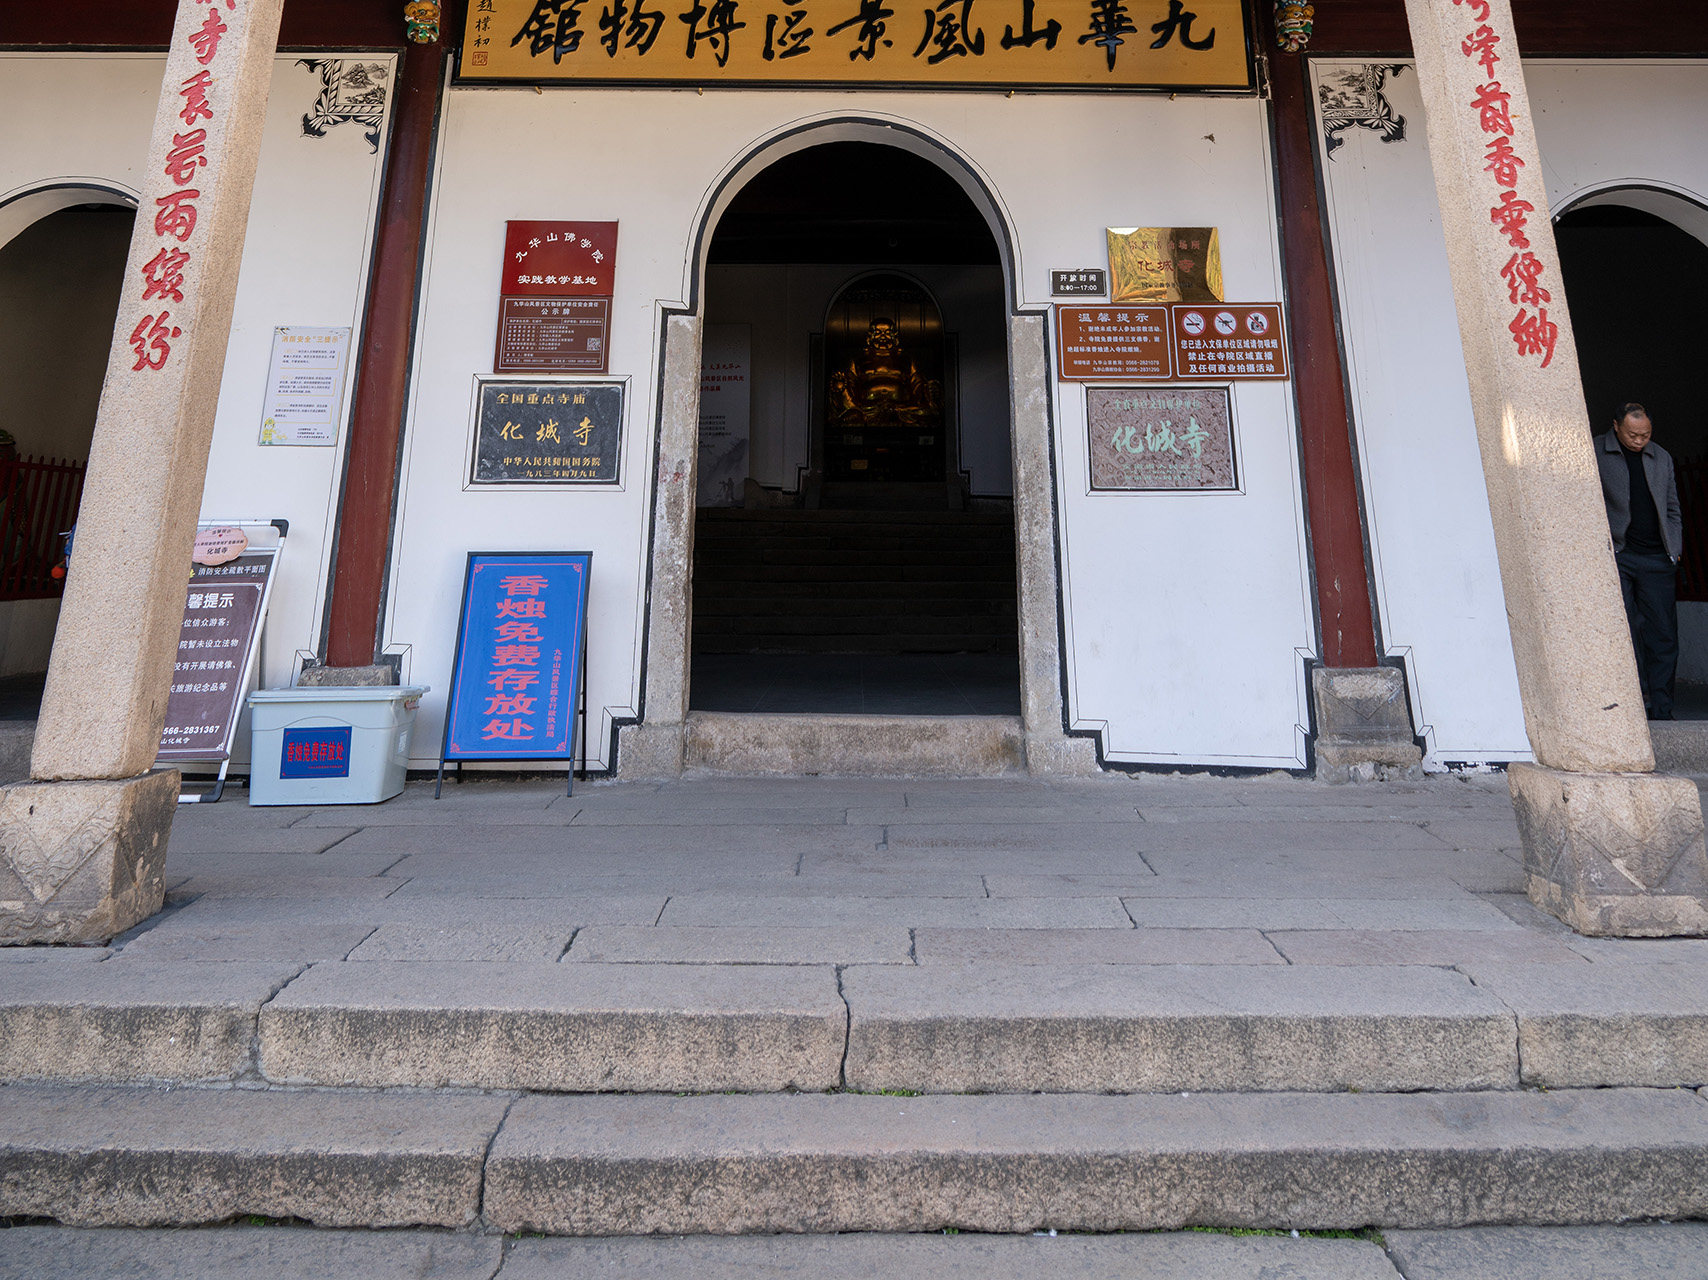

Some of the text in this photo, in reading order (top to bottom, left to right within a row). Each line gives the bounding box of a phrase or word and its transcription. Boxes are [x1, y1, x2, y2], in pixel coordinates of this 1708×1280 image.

[515, 232, 605, 264] 九华山佛学院
[1137, 258, 1196, 274] 化城寺
[517, 274, 599, 286] 实践教学基地
[1059, 273, 1097, 282] 开放时间
[540, 308, 571, 316] 公示牌
[1078, 311, 1150, 323] 温馨提示
[1180, 339, 1279, 350] 您已进入文保单位区域请勿吸烟
[1187, 351, 1274, 361] 禁止在寺院区域直播
[1189, 363, 1276, 374] 及任何商业拍摄活动
[496, 392, 587, 405] 全国重点寺庙
[500, 416, 596, 446] 化城寺
[1111, 416, 1211, 459] 化城寺
[503, 456, 602, 467] 中华人民共和国国务院
[206, 546, 229, 555] 化城寺
[197, 564, 267, 576] 消防安全疏散平面图
[185, 592, 235, 609] 馨提示
[181, 617, 230, 627] 位信众游客:
[178, 638, 240, 650] 院暂未设立法物
[480, 574, 549, 741] 香烛免费存放处
